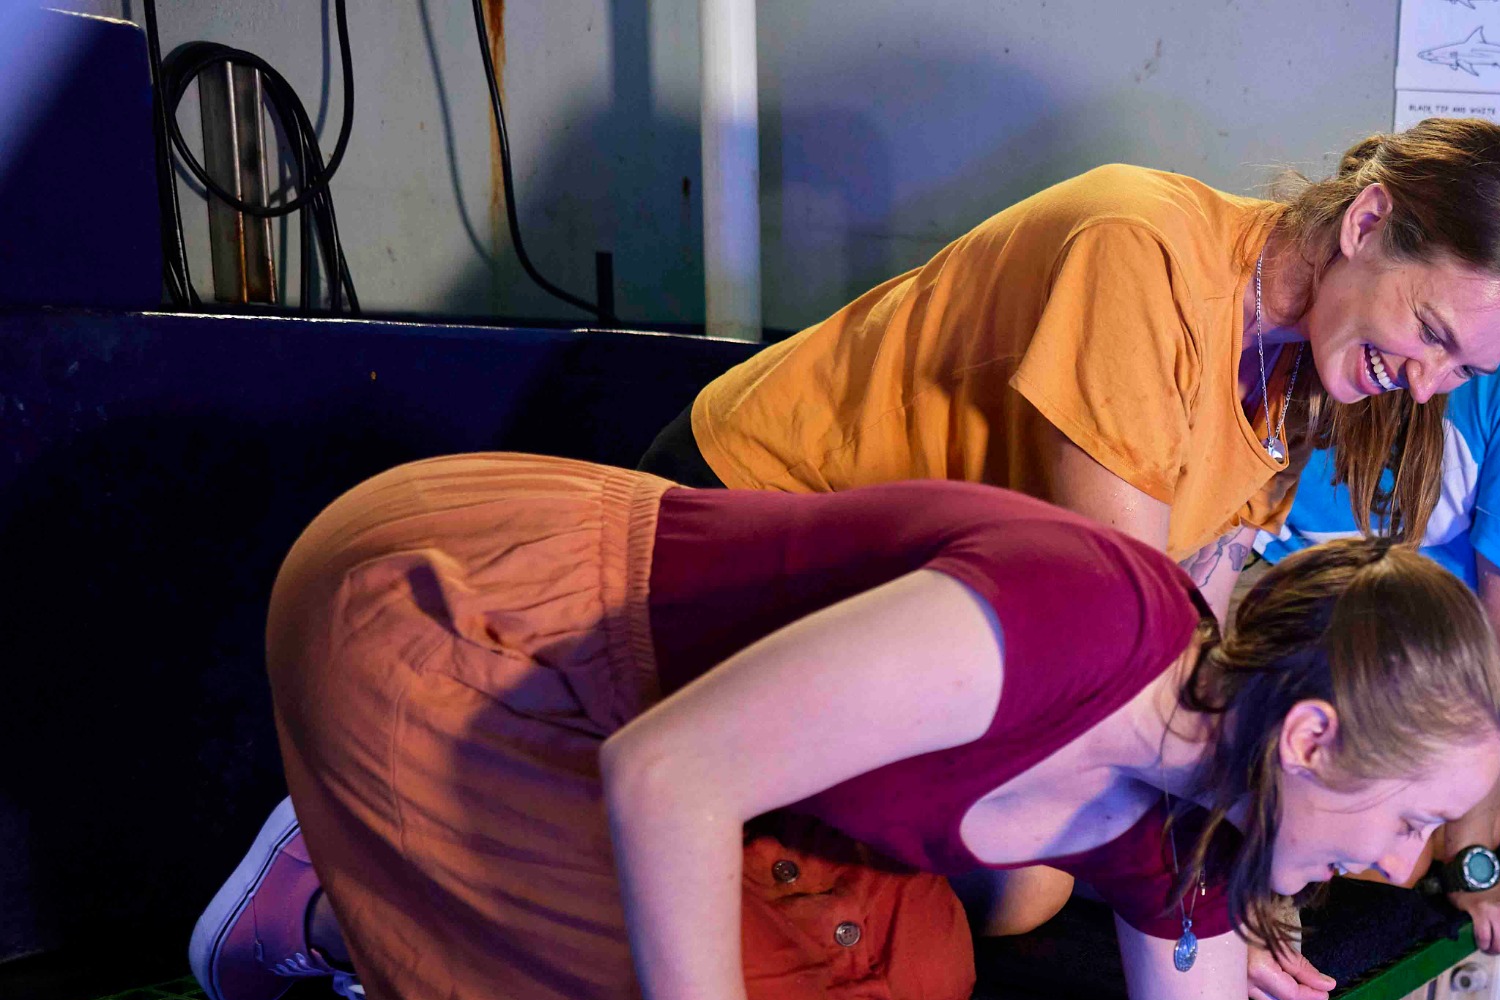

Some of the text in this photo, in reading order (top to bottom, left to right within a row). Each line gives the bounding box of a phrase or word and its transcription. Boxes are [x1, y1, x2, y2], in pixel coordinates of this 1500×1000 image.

[1408, 104, 1432, 113] BLACK
[1435, 105, 1448, 113] TIP
[1470, 107, 1496, 115] WHITE
